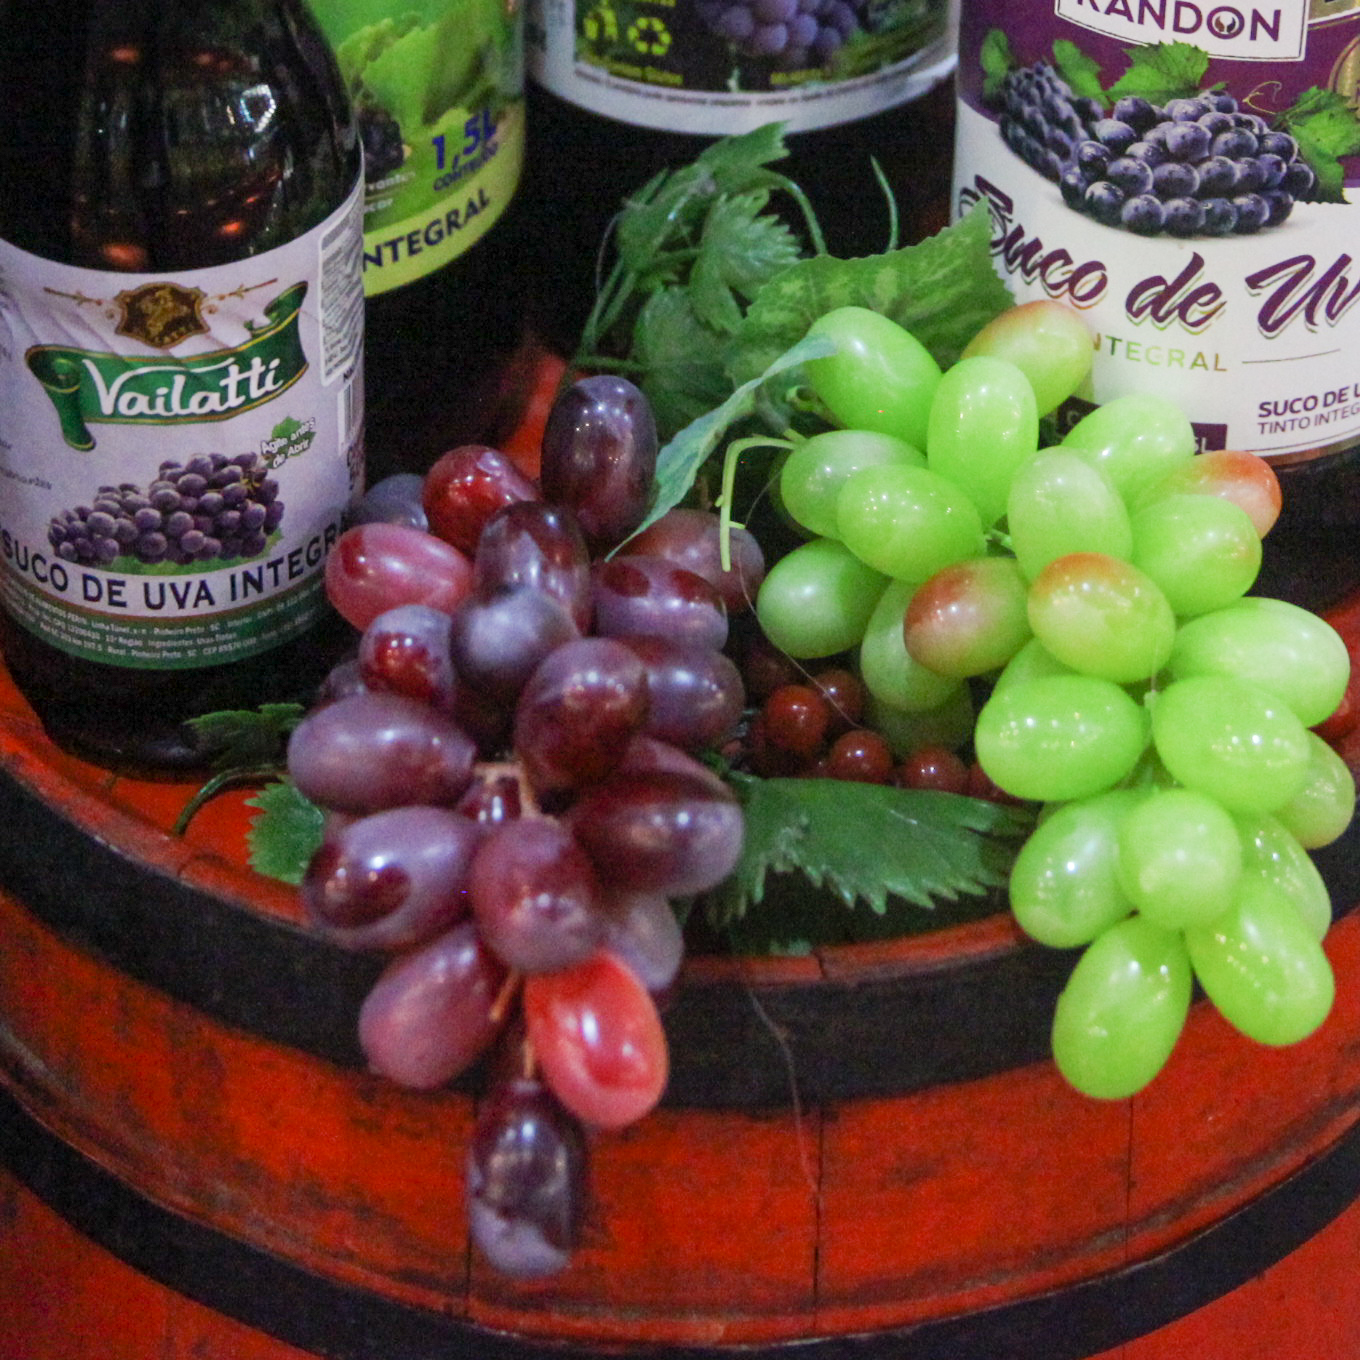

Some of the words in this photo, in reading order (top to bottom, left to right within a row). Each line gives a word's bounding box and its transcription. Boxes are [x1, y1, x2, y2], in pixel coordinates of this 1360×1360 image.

[431, 109, 497, 171] 1,5L
[363, 188, 489, 273] NTEGRAL
[958, 173, 1109, 311] Suco
[1124, 251, 1228, 335] de
[1092, 332, 1229, 372] NTEGRAL
[82, 356, 284, 417] Vailatti
[1258, 395, 1319, 418] SUCO
[1323, 385, 1350, 408] DE
[1257, 416, 1311, 435] TINTO
[1, 528, 70, 593] SUCO
[81, 573, 128, 609] DE
[142, 579, 216, 611] UVA
[229, 522, 340, 602] INTEGR
